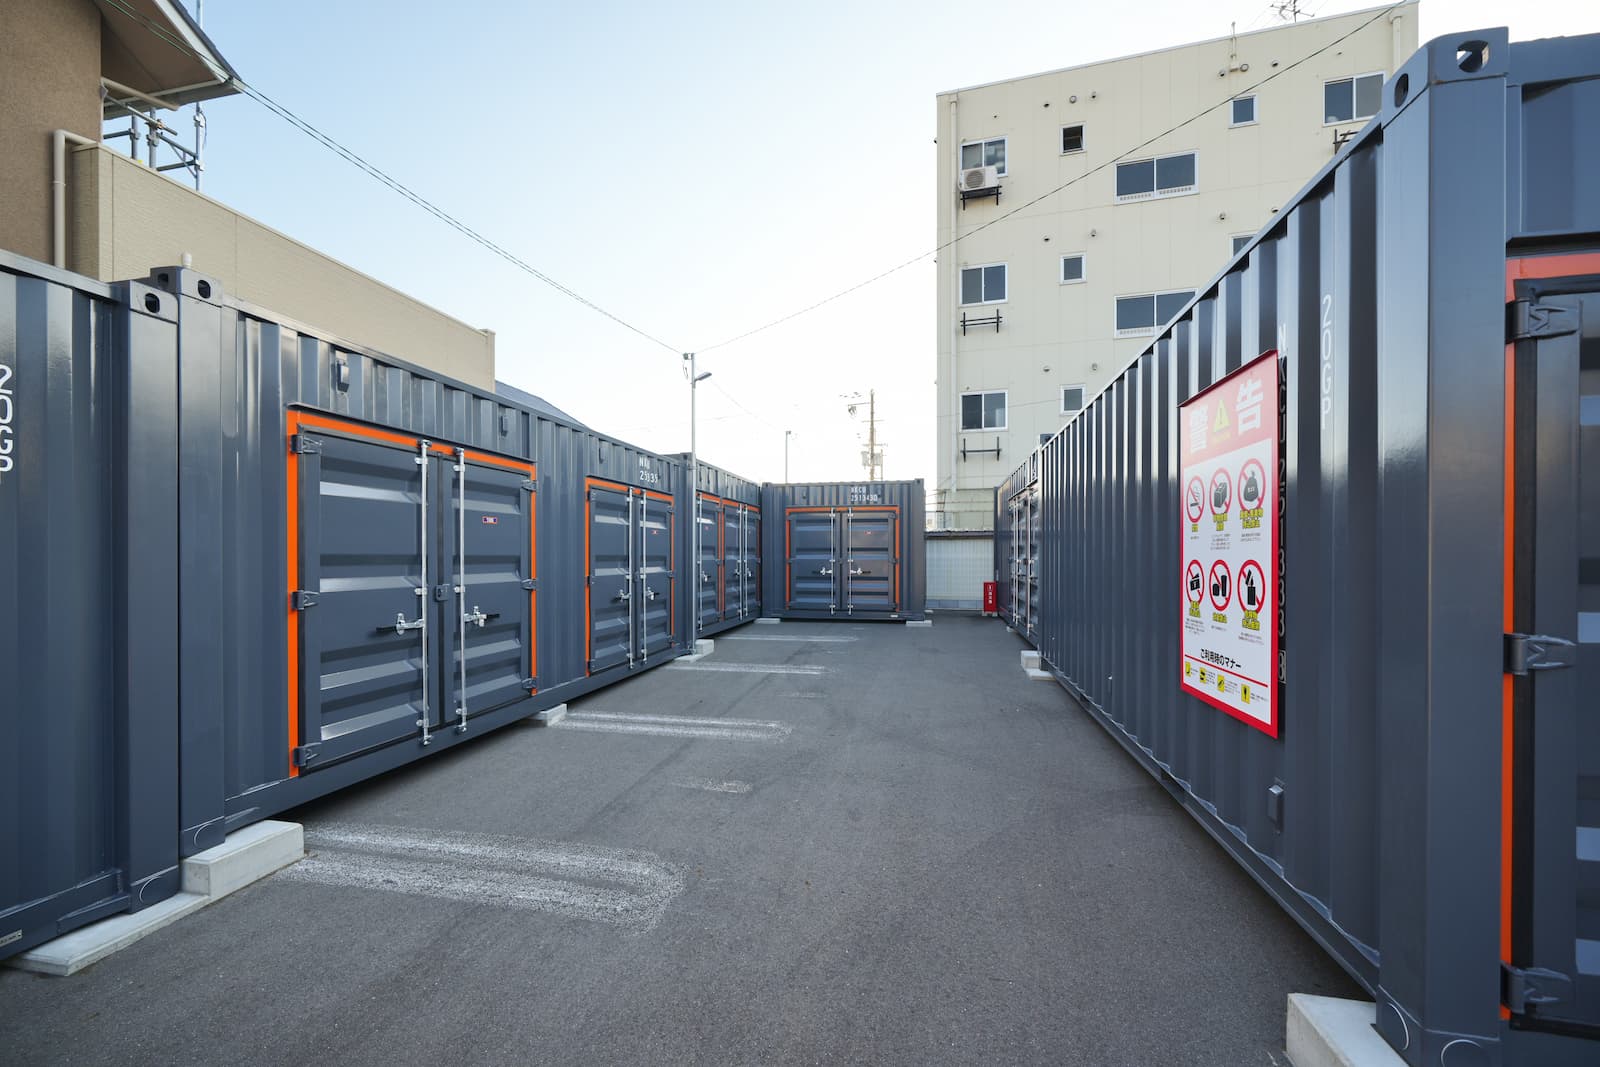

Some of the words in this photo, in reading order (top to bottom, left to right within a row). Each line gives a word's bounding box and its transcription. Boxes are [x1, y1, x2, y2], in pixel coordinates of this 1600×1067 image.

[1322, 294, 1331, 430] 20GP
[1200, 648, 1242, 669] ご利用時のマナー
